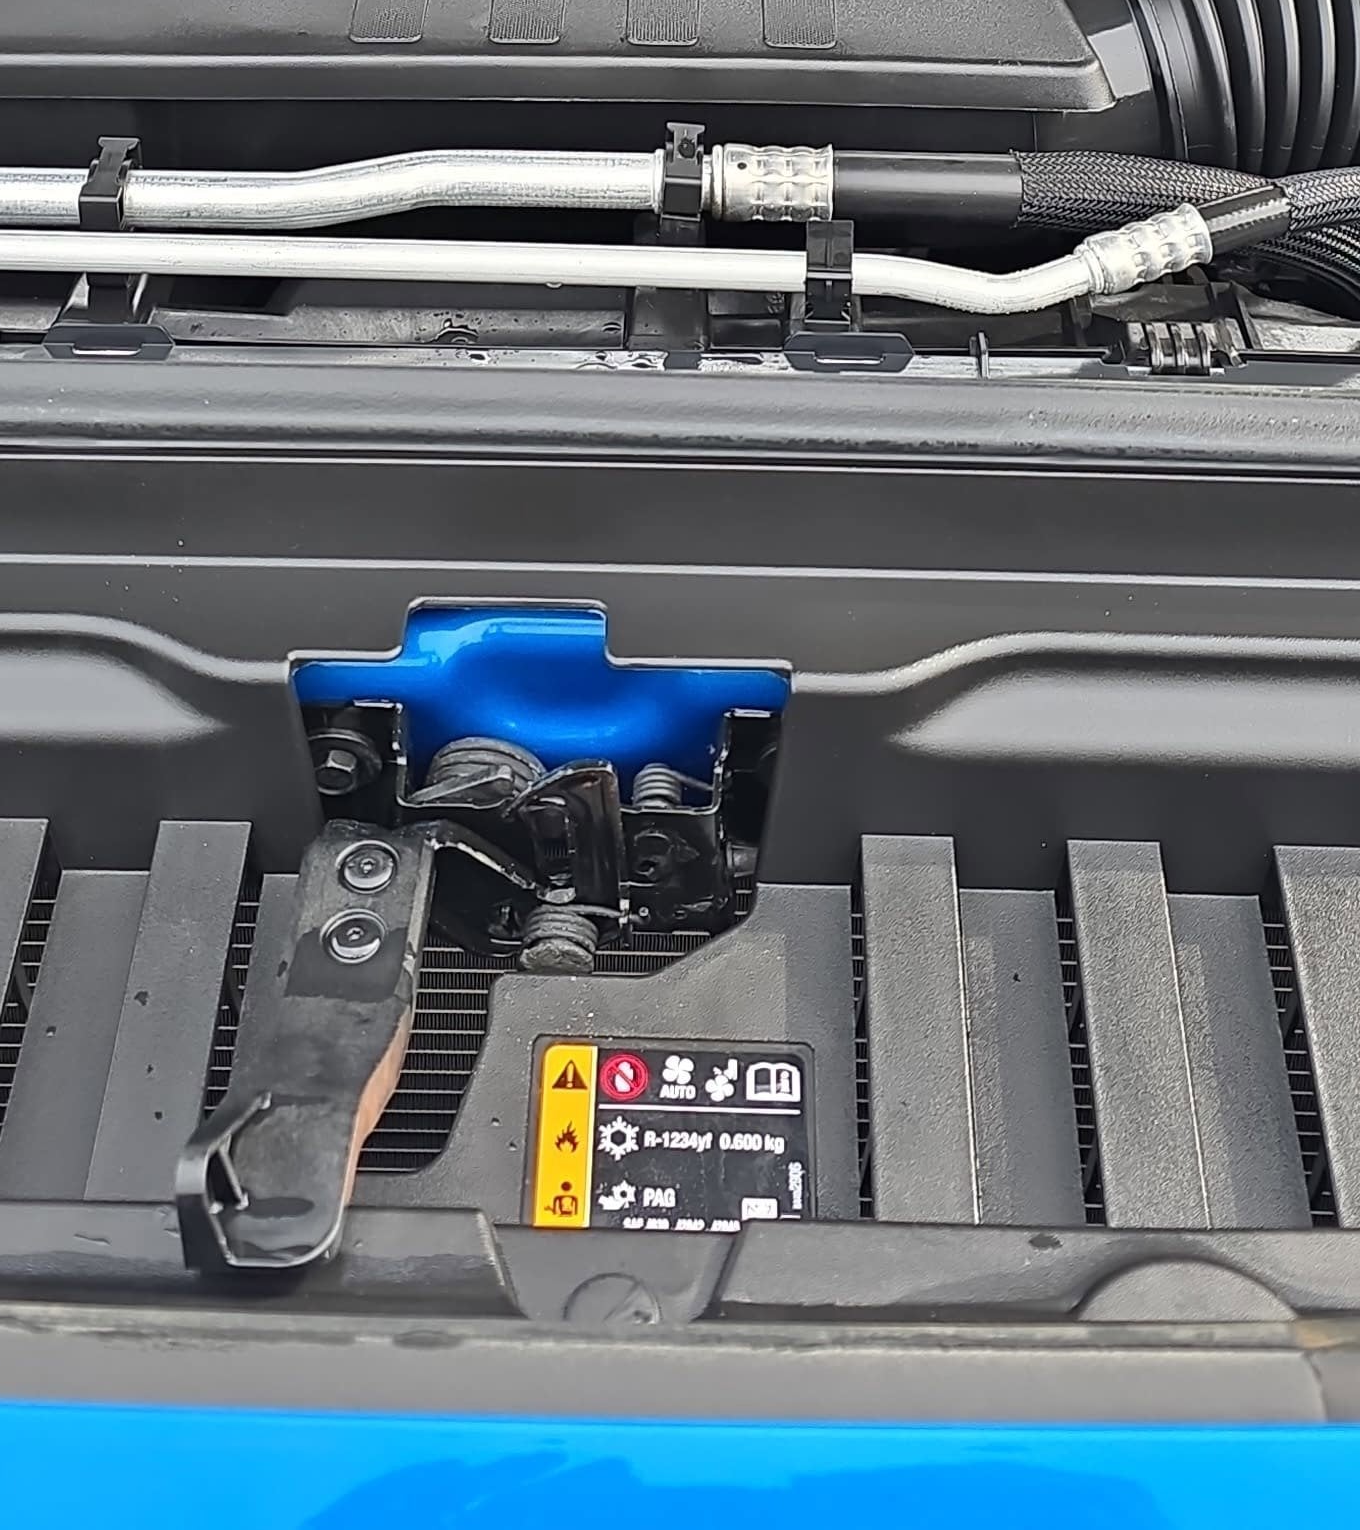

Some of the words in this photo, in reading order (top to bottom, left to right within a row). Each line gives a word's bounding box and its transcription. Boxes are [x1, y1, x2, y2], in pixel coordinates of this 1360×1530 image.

[659, 1084, 697, 1100] AUTO
[644, 1130, 713, 1153] R-1234yf
[719, 1133, 763, 1151] 0.600
[765, 1134, 786, 1155] kg
[643, 1188, 676, 1208] PAG
